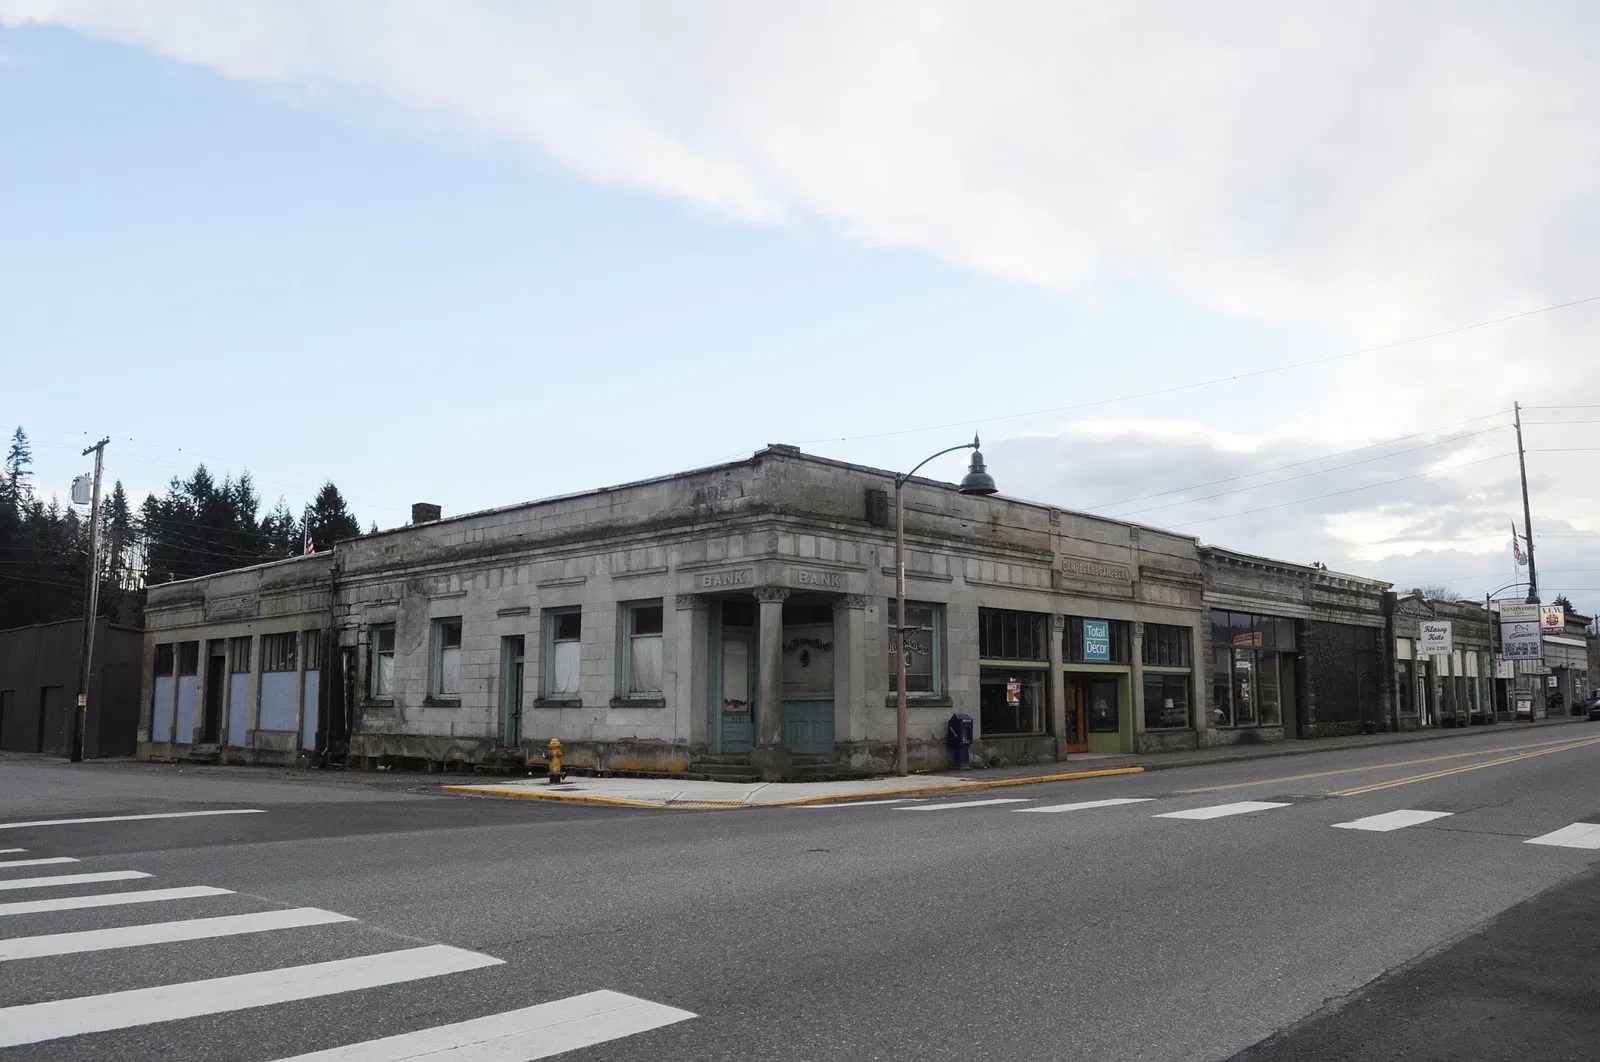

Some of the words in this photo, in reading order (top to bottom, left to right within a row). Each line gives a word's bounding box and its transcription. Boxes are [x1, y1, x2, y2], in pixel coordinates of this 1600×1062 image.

[702, 570, 745, 588] BANK
[798, 570, 842, 589] BANK
[1086, 625, 1105, 637] Total
[1423, 625, 1448, 634] Klassy
[1086, 640, 1108, 654] Décor
